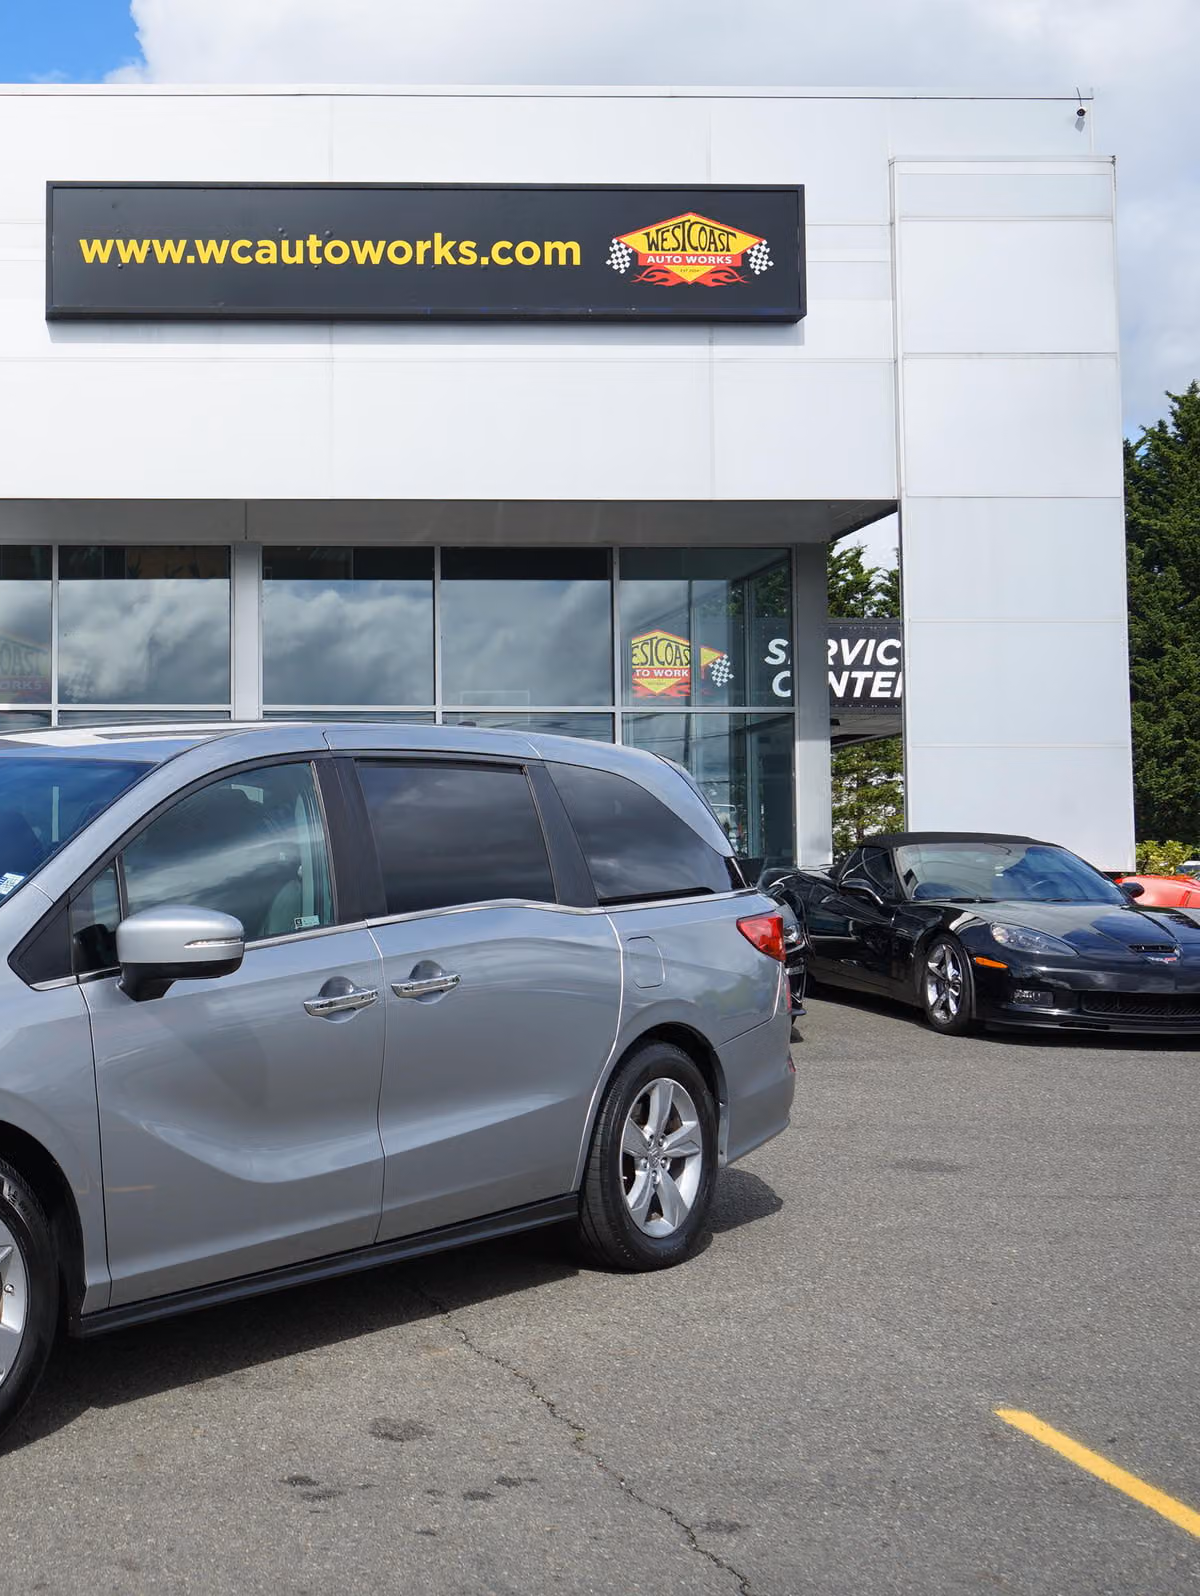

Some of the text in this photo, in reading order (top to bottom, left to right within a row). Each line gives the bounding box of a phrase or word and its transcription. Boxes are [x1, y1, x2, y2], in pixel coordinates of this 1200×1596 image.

[80, 233, 580, 265] www.wcautoworks.com
[647, 255, 733, 264] AUTO WORKS
[764, 638, 902, 666] SRVIC
[653, 669, 689, 677] WORK
[772, 670, 902, 698] CNTE
